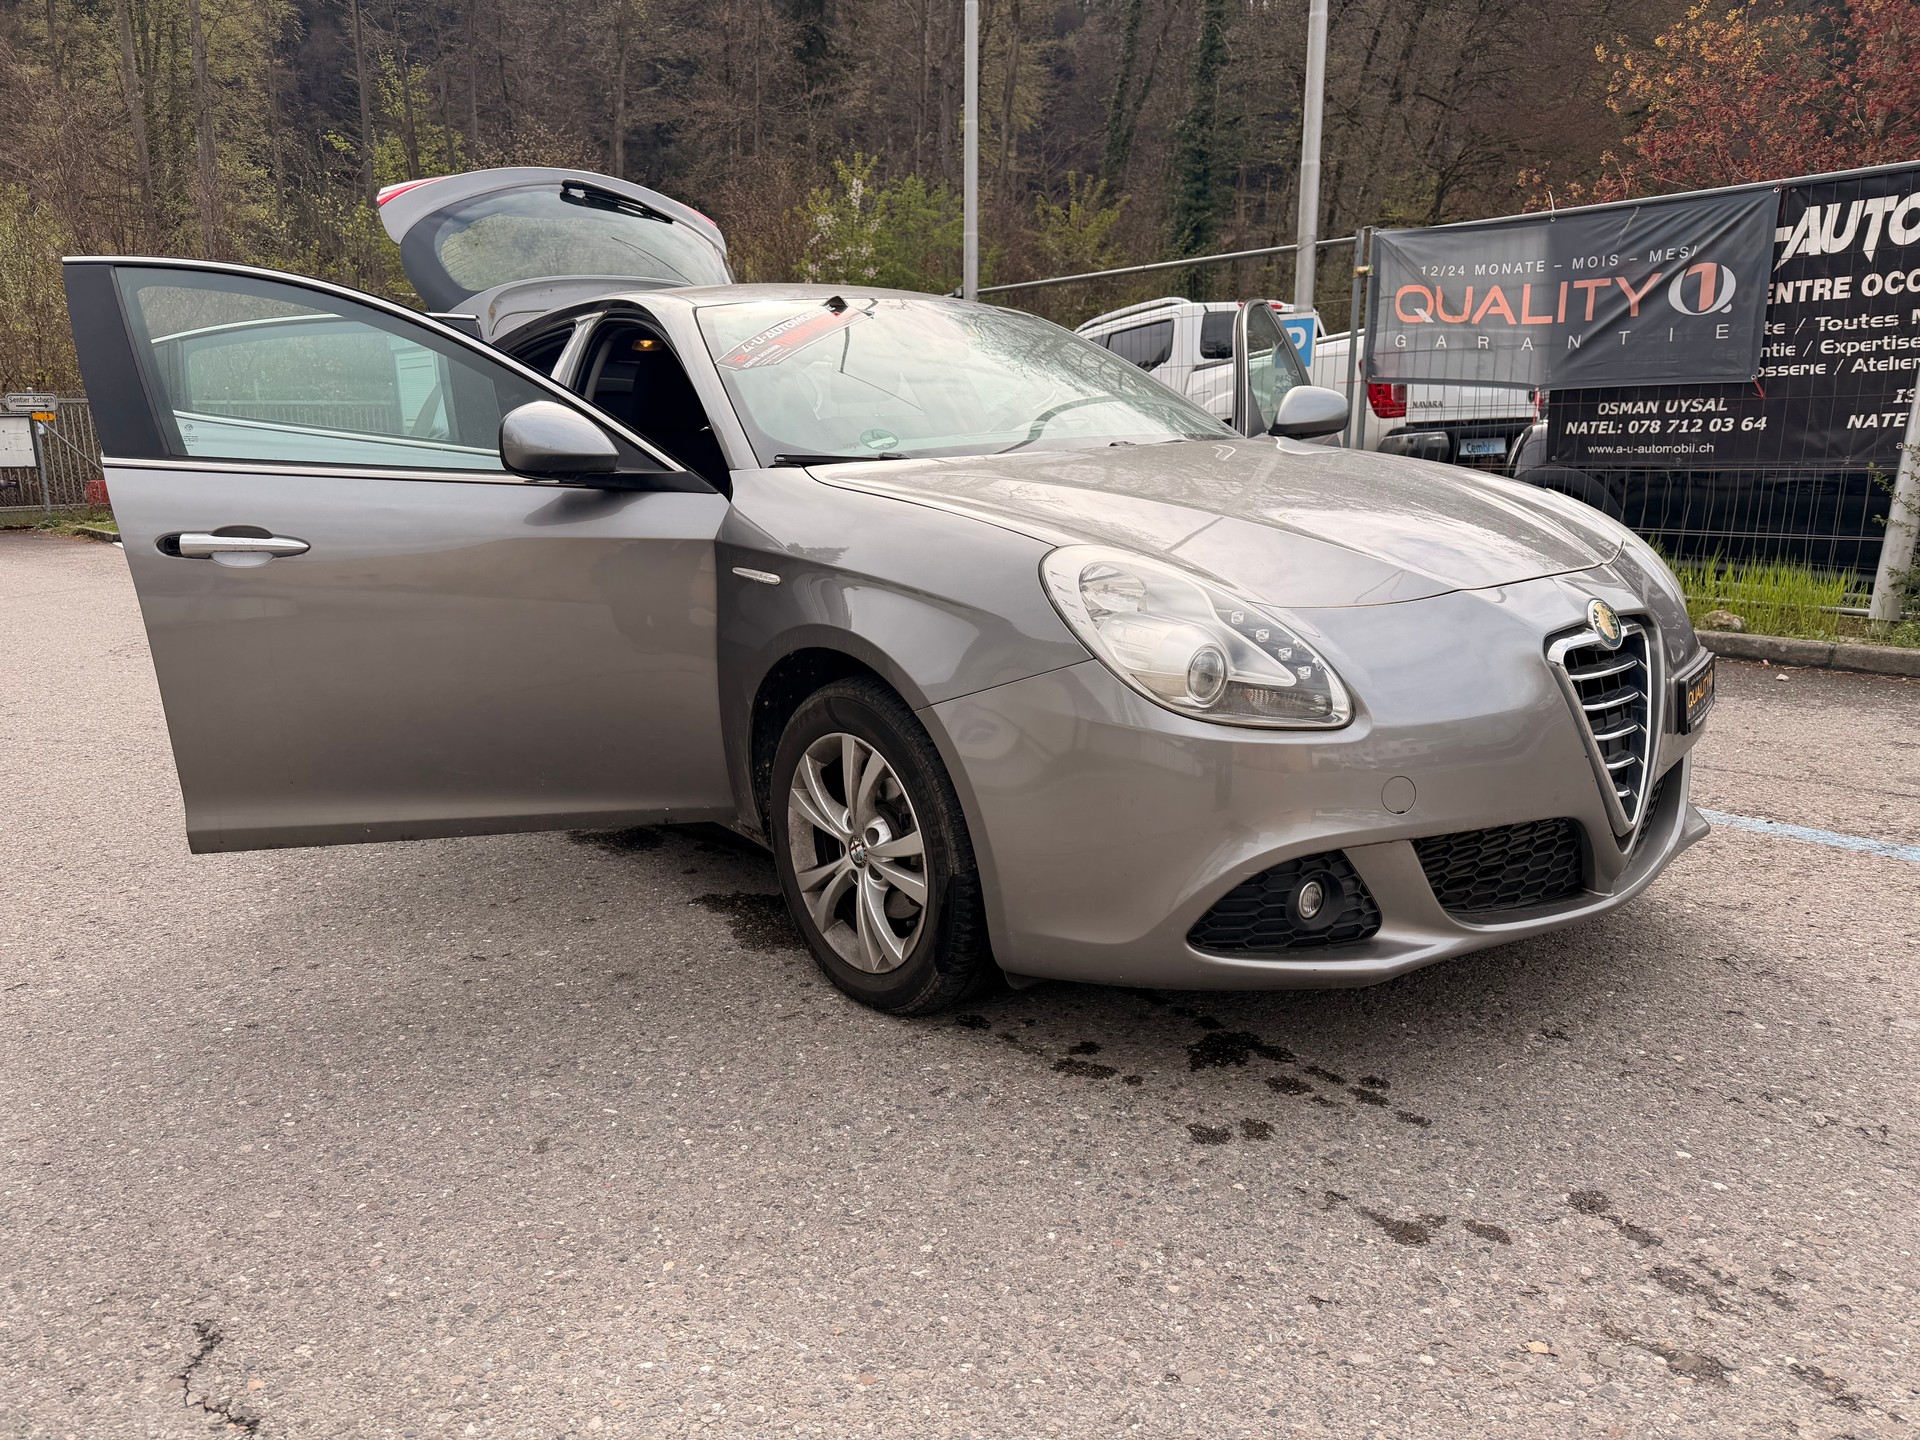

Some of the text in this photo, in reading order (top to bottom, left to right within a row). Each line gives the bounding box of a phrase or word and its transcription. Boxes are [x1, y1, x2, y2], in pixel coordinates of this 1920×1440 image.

[1421, 265, 1466, 277] 12/24
[1475, 260, 1546, 276] MONATE
[1572, 254, 1619, 269] MOIS
[1649, 245, 1698, 263] MESI
[1395, 272, 1663, 325] QUALITY
[1814, 313, 1900, 332] Toutes
[1395, 324, 1730, 351] GARANTIE
[1820, 334, 1920, 357] Expertise
[1850, 355, 1920, 374] Atelier
[8, 396, 31, 404] Sentier
[1597, 397, 1728, 415] OSMAN UYSAL
[1565, 416, 1768, 435] NATEL: 078 712 03 64
[1846, 412, 1910, 429] NATE
[1588, 442, 1715, 454] www.a-u-automobil.ch
